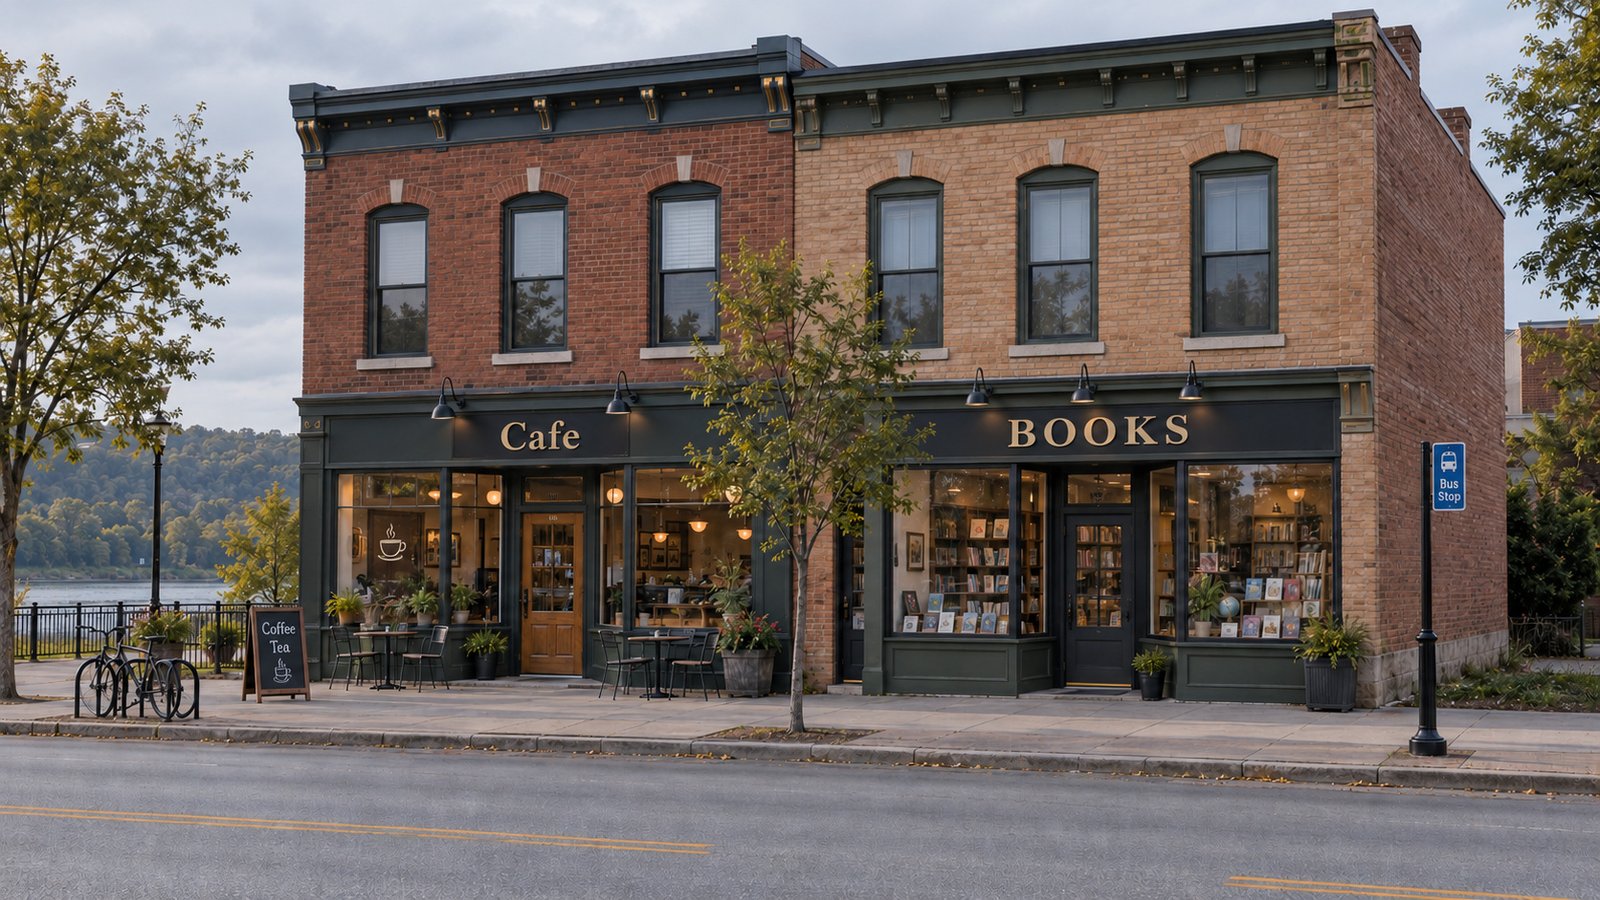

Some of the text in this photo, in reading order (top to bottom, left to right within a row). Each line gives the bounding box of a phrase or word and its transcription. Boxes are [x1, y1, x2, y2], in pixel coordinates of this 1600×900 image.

[500, 419, 580, 451] Cafe
[1008, 414, 1190, 448] BOOKS
[1439, 478, 1459, 489] Bus
[1438, 491, 1461, 504] Stop
[261, 621, 296, 635] Coffee
[269, 639, 291, 654] Tea
